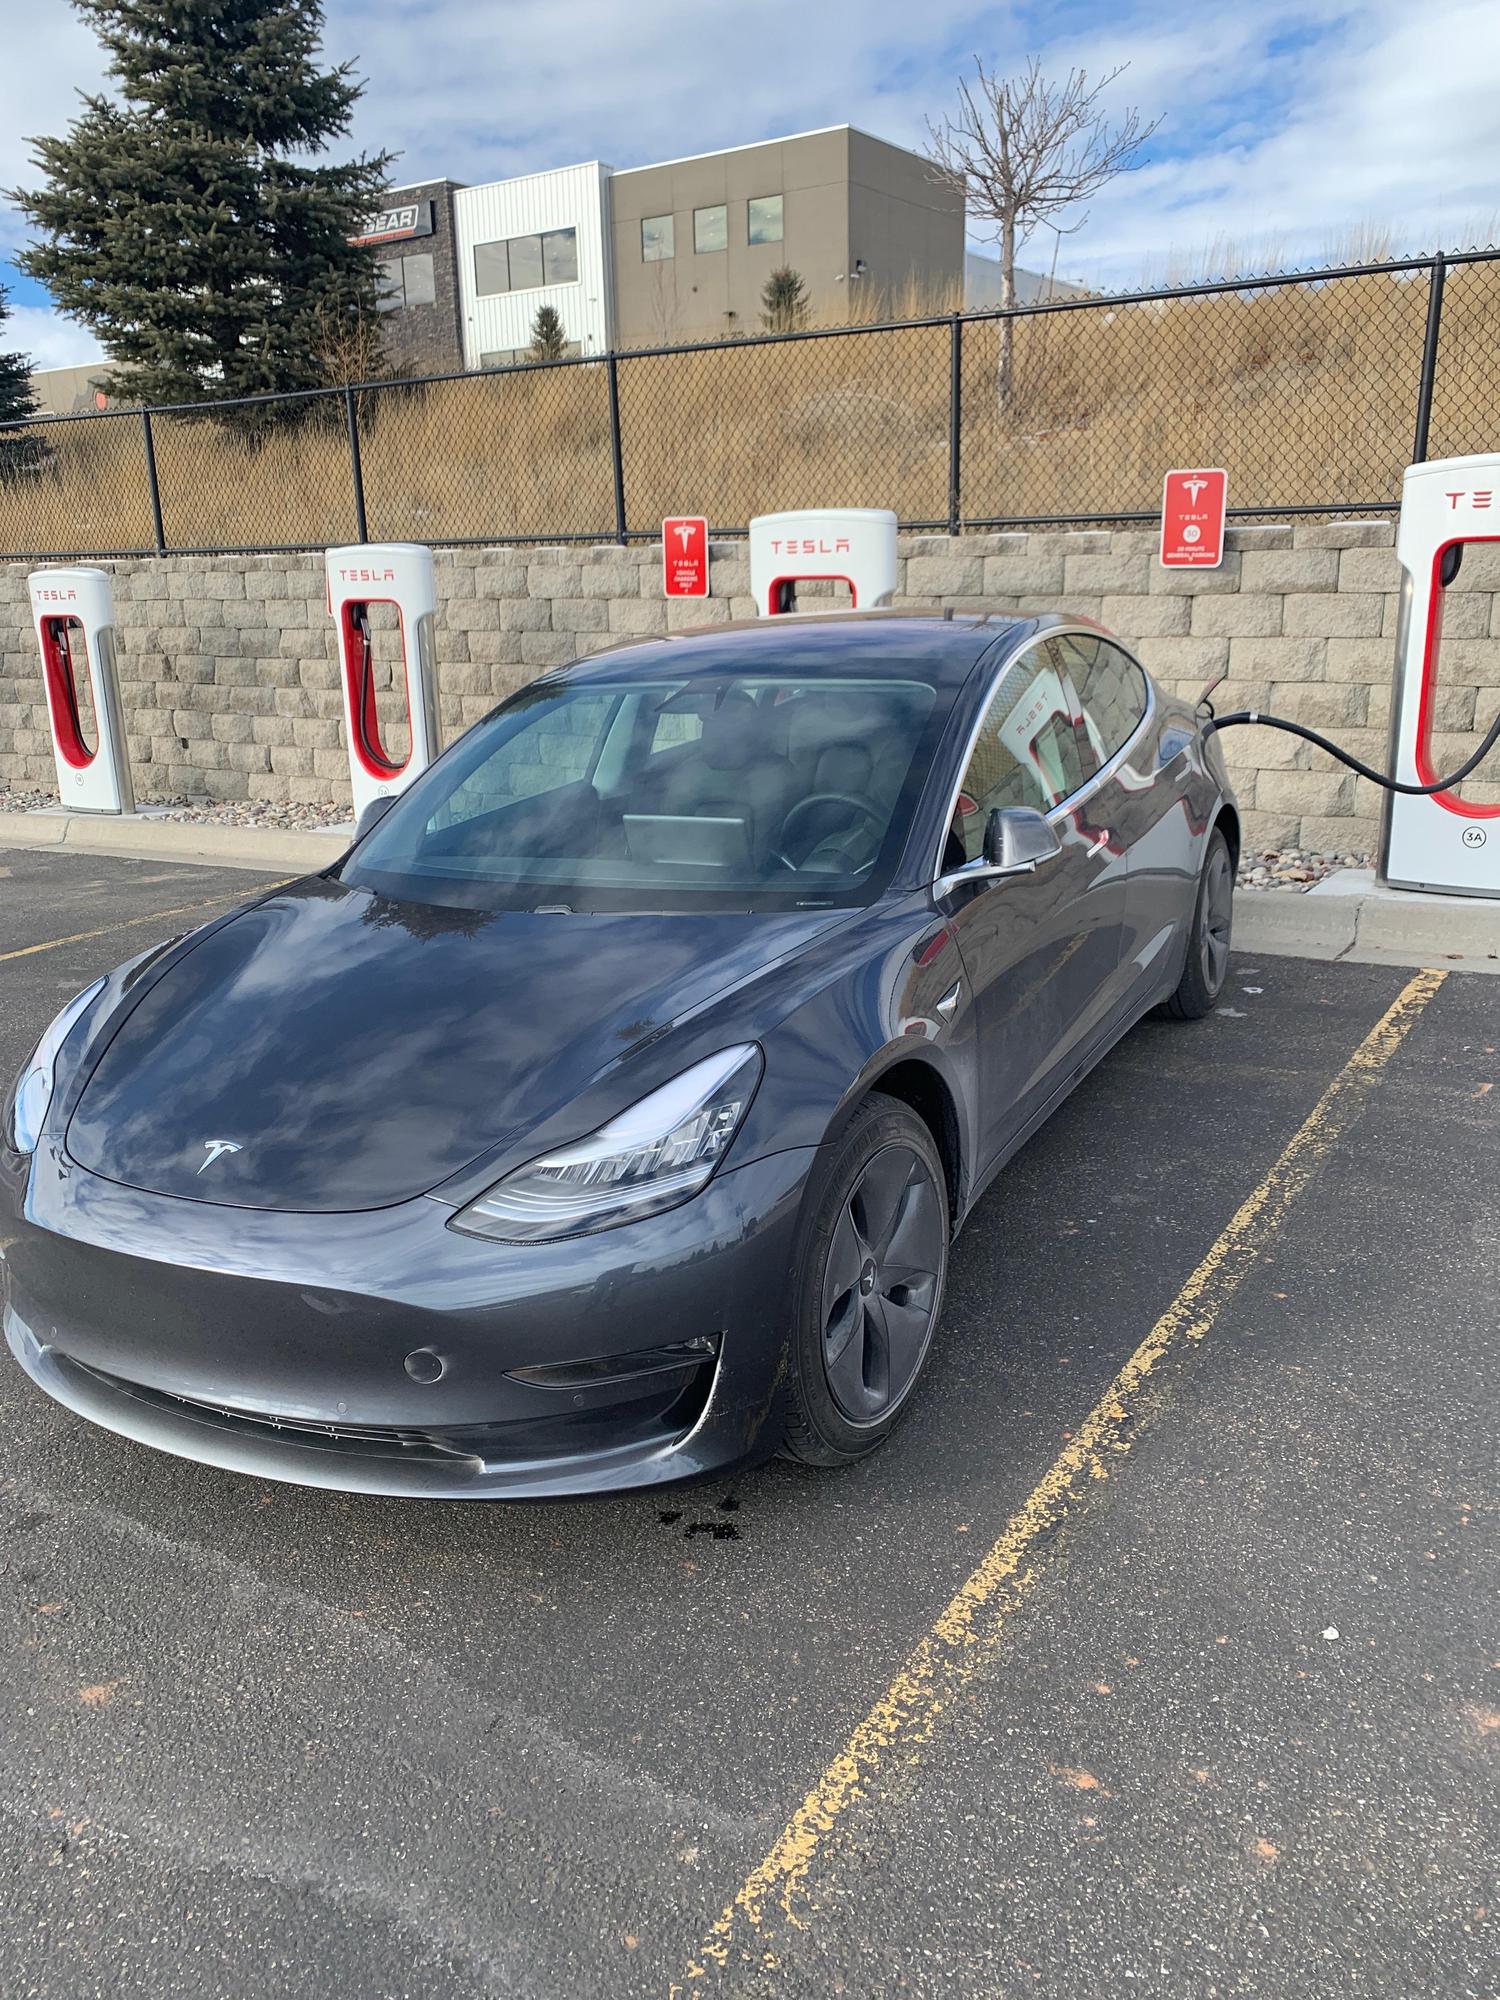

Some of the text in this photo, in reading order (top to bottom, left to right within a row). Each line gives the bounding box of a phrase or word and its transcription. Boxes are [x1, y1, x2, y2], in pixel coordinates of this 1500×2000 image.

[1178, 513, 1209, 521] TESLA
[771, 538, 850, 554] TESLA
[672, 559, 699, 567] TESLA
[339, 569, 395, 581] TESLA
[36, 590, 77, 600] TESLA
[1467, 832, 1482, 842] 3A
